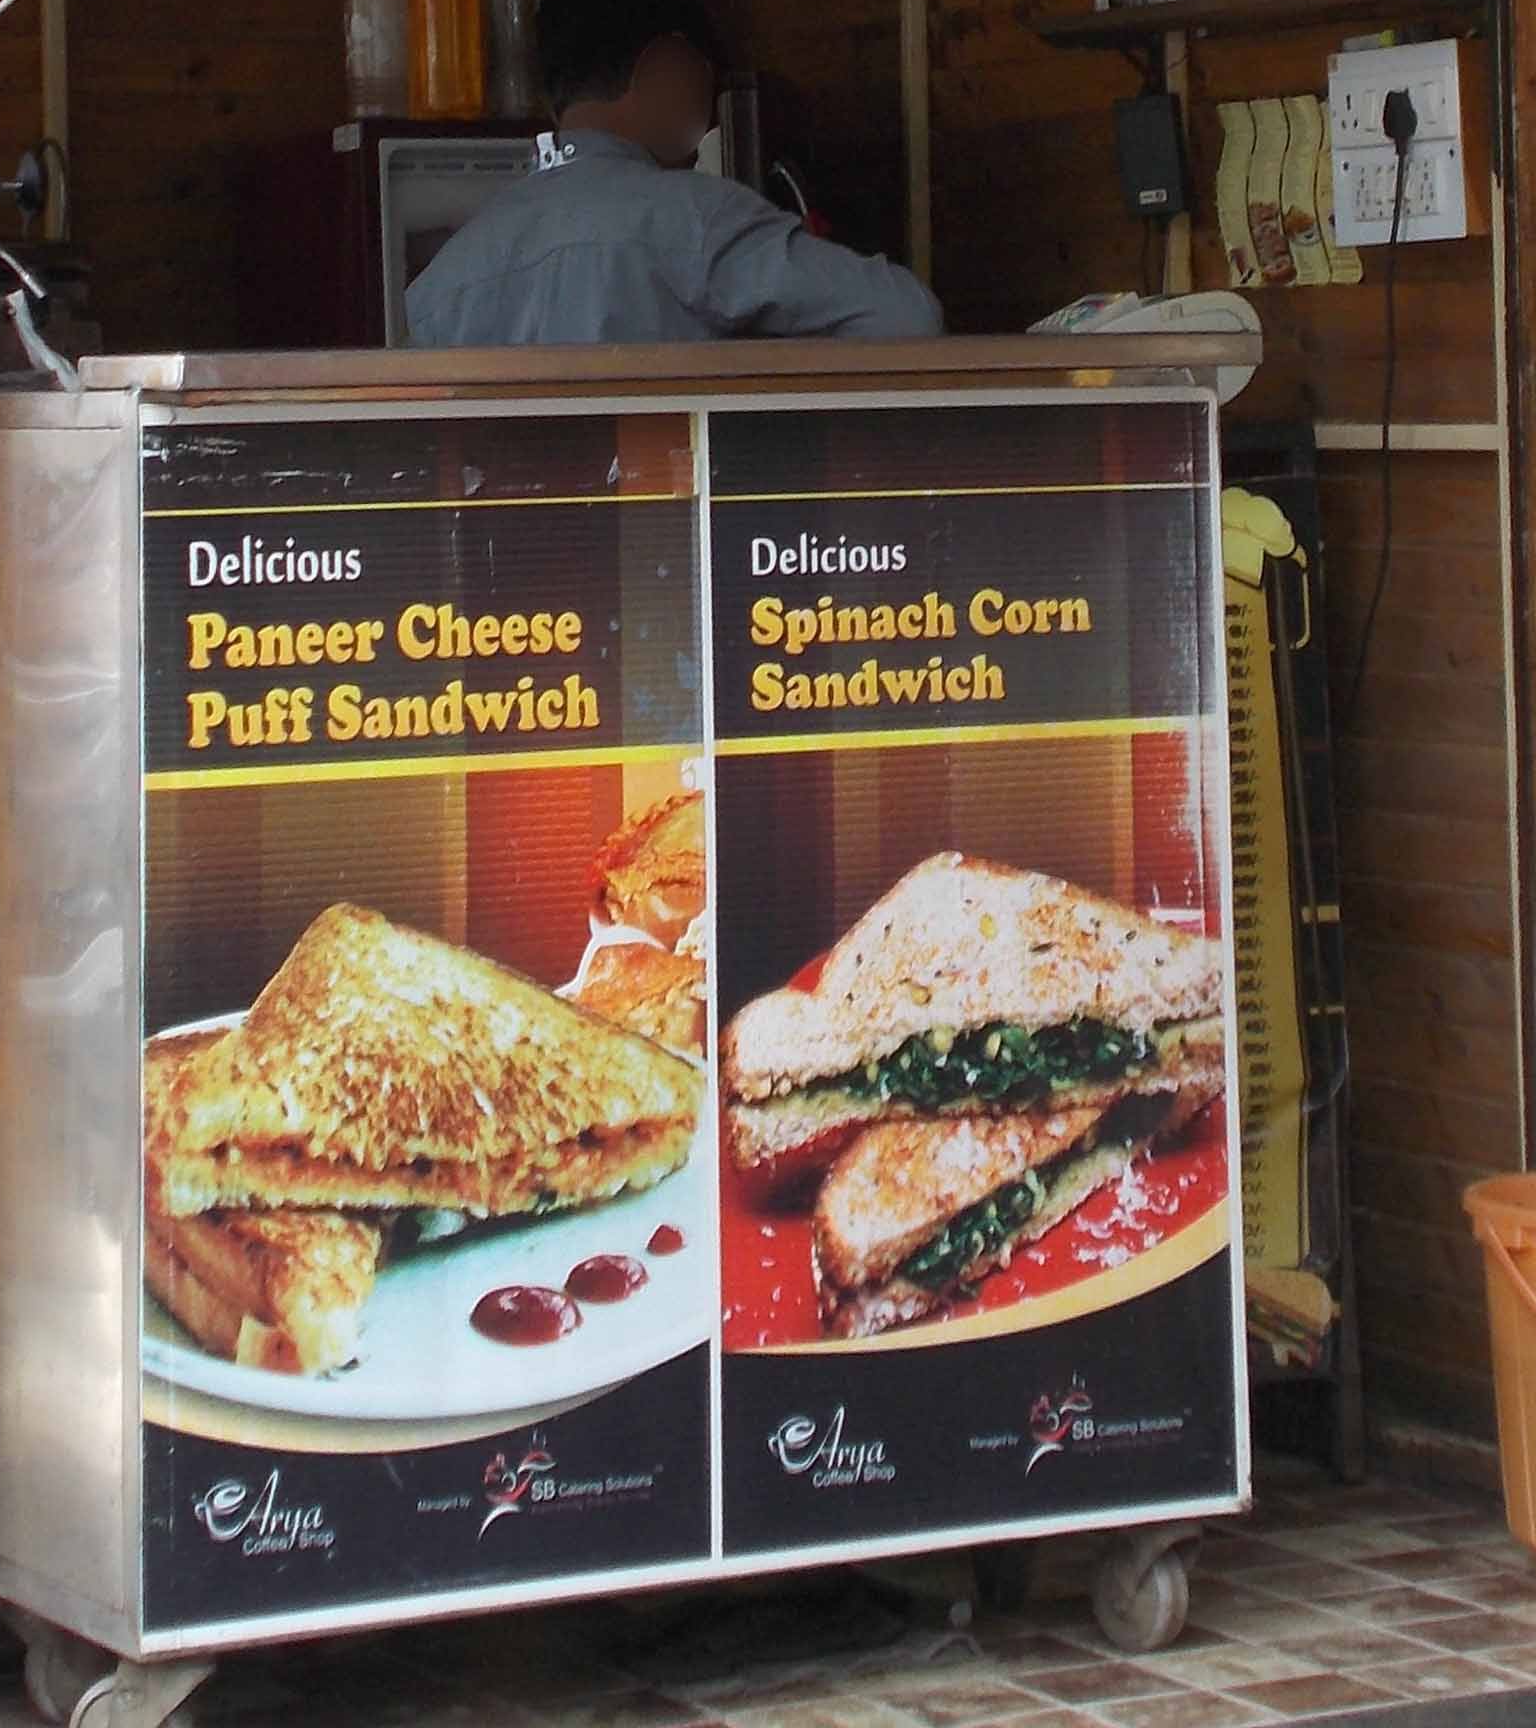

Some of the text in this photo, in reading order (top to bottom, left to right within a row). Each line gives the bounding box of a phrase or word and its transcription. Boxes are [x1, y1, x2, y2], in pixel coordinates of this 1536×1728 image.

[189, 534, 362, 588] Delicious
[751, 532, 907, 577] Delicious
[186, 601, 584, 671] Paneer Cheese
[750, 587, 1093, 656] Spinach Corn
[751, 653, 1007, 712] Sandwich
[186, 673, 602, 750] Puff Sandwich
[779, 1402, 886, 1480] Arya
[1072, 1420, 1096, 1441] SB
[530, 1480, 555, 1502] SB
[812, 1464, 896, 1489] Coffee Shop
[204, 1468, 325, 1552] Arya
[242, 1528, 335, 1557] Coffee Shop
